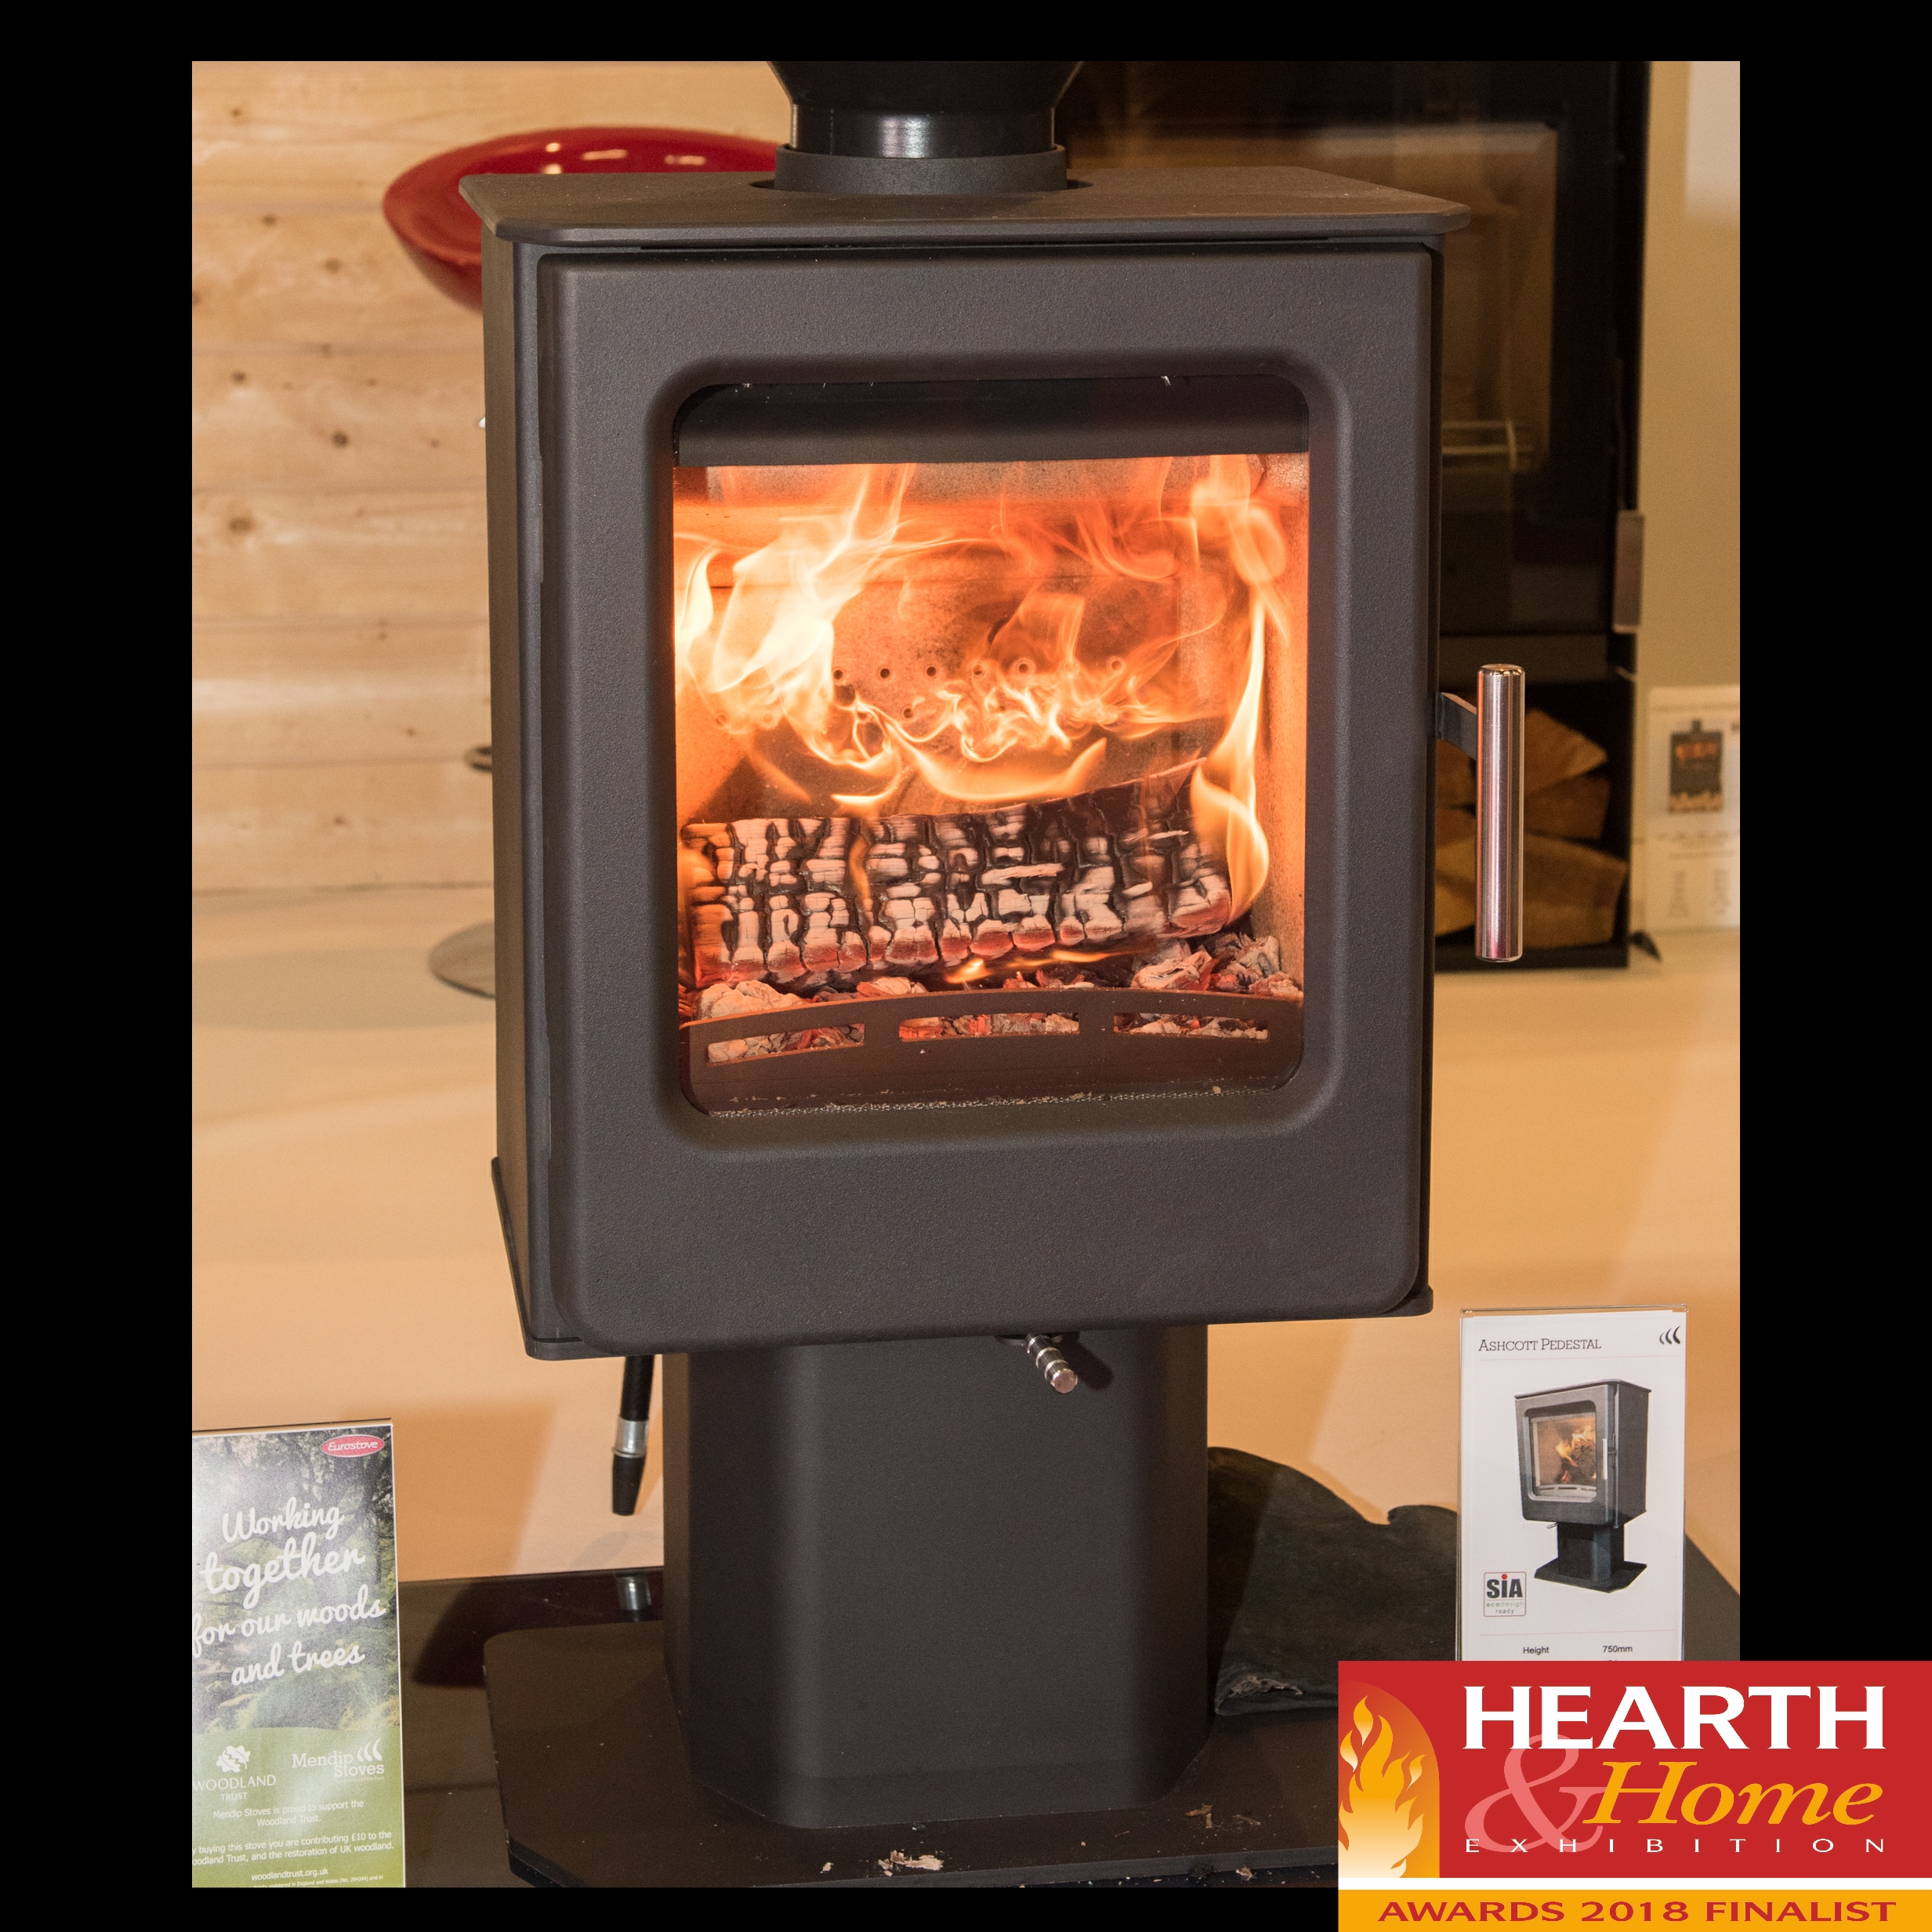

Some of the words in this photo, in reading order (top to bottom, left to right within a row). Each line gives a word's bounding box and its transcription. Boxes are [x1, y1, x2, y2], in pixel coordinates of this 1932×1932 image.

[1478, 1339, 1538, 1351] ASHCOTT
[1541, 1339, 1601, 1350] PEDESTAL
[328, 1441, 378, 1452] Eurostove
[223, 1497, 345, 1542] Working
[199, 1531, 365, 1609] together
[192, 1613, 236, 1658] for
[241, 1615, 292, 1637] our
[297, 1584, 386, 1627] woods
[1523, 1647, 1550, 1655] Height
[231, 1642, 285, 1685] and
[288, 1640, 365, 1673] trees
[292, 1750, 353, 1768] Mendip
[334, 1764, 385, 1778] Stoves
[192, 1774, 277, 1792] WOODLAND
[220, 1792, 248, 1801] TRUST
[213, 1810, 242, 1818] Mendip
[245, 1807, 271, 1816] Stoves
[282, 1803, 306, 1814] proud
[308, 1803, 317, 1811] to
[318, 1801, 349, 1811] support
[256, 1817, 296, 1827] Woodland
[299, 1814, 321, 1823] Trust.
[198, 1845, 226, 1854] buying
[245, 1842, 266, 1850] stove
[269, 1840, 284, 1850] you
[301, 1835, 349, 1846] contributing
[351, 1832, 366, 1841] £10
[226, 1854, 249, 1863] Trust,
[252, 1852, 266, 1861] and
[269, 1850, 282, 1859] the
[285, 1847, 328, 1858] restoration
[329, 1846, 339, 1854] of
[340, 1844, 352, 1853] UK
[353, 1842, 394, 1852] woodland.
[252, 1867, 328, 1881] woodlandtrust.org.uk
